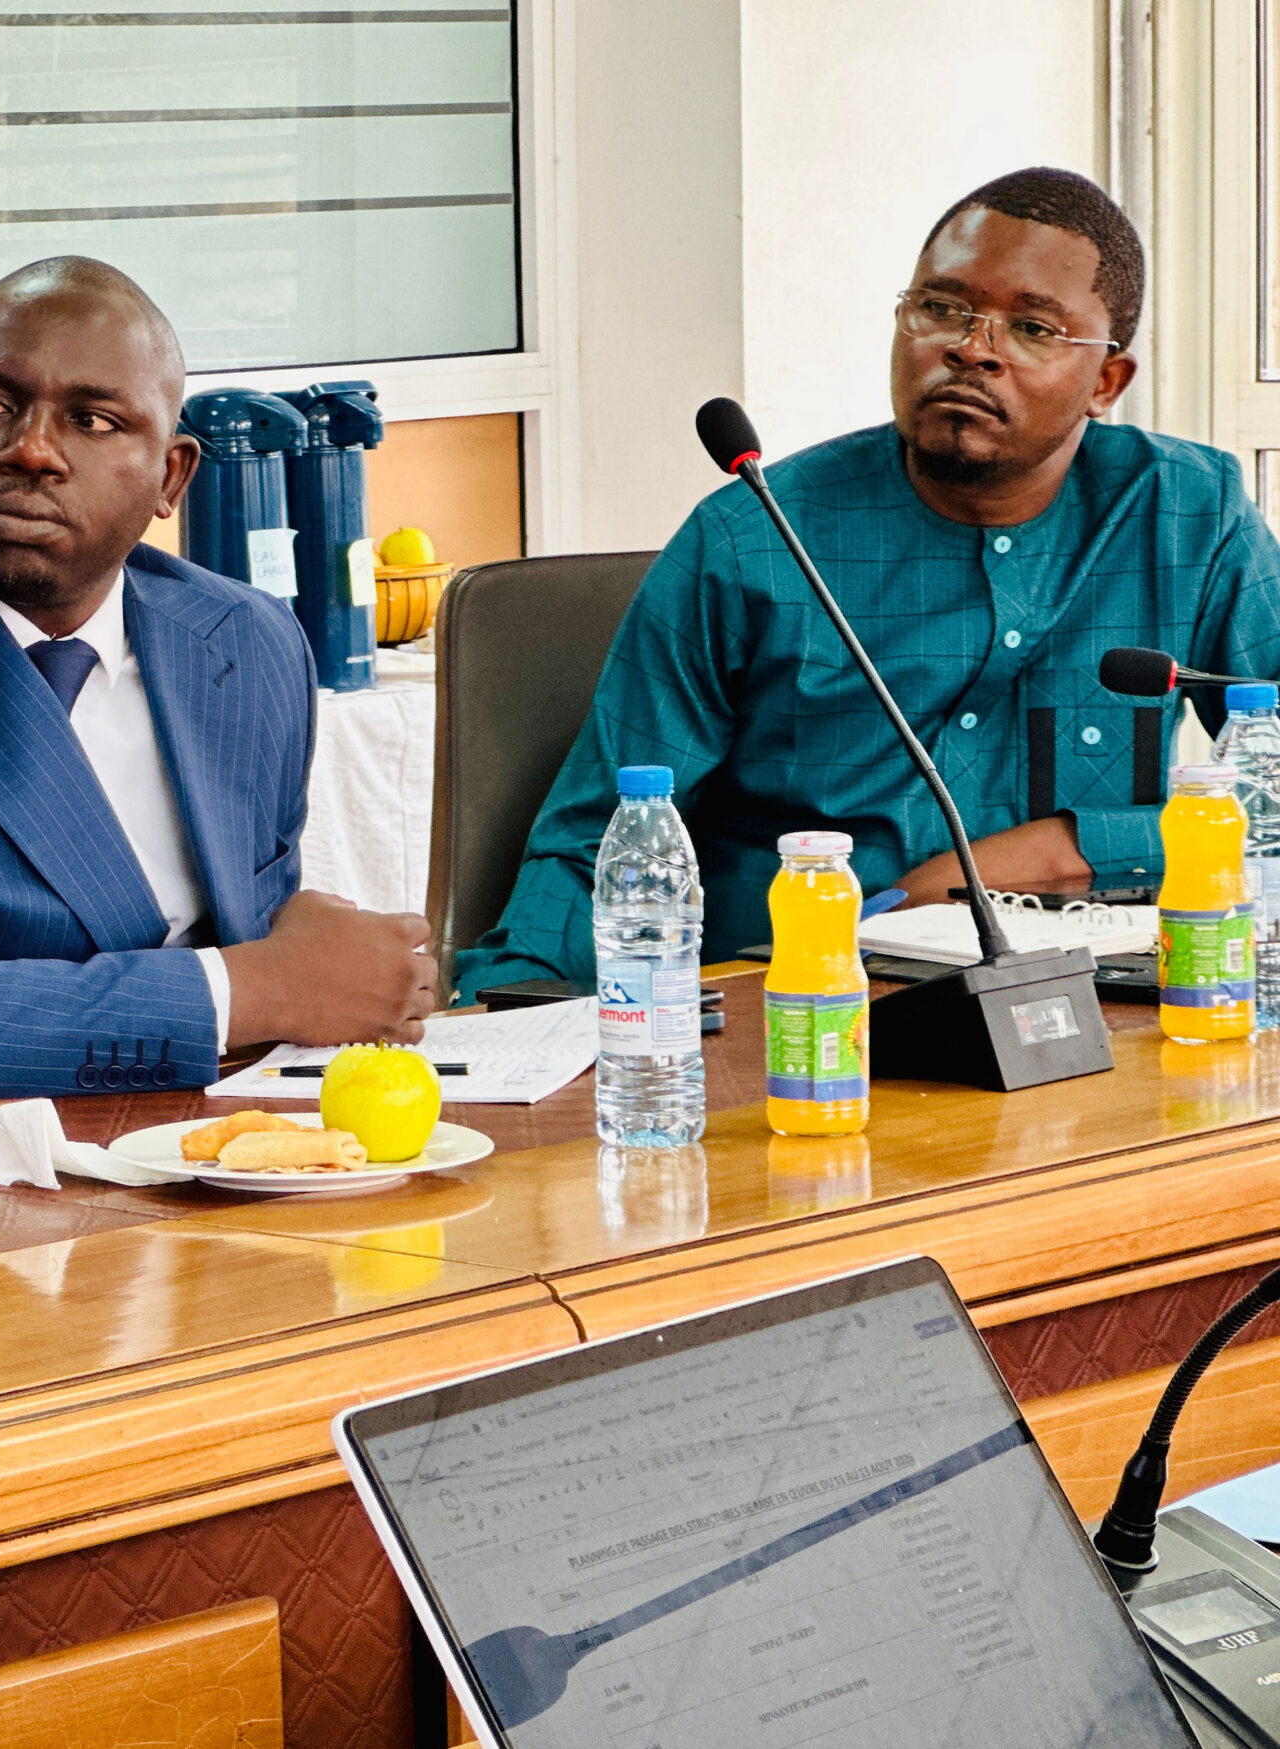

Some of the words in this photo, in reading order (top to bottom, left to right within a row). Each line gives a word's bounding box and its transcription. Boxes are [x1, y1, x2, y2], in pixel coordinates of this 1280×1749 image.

[568, 1545, 616, 1568] PLANNING
[629, 1529, 670, 1549] PASSAGE
[669, 1523, 687, 1537] DES
[686, 1507, 741, 1532] STRUCTURES
